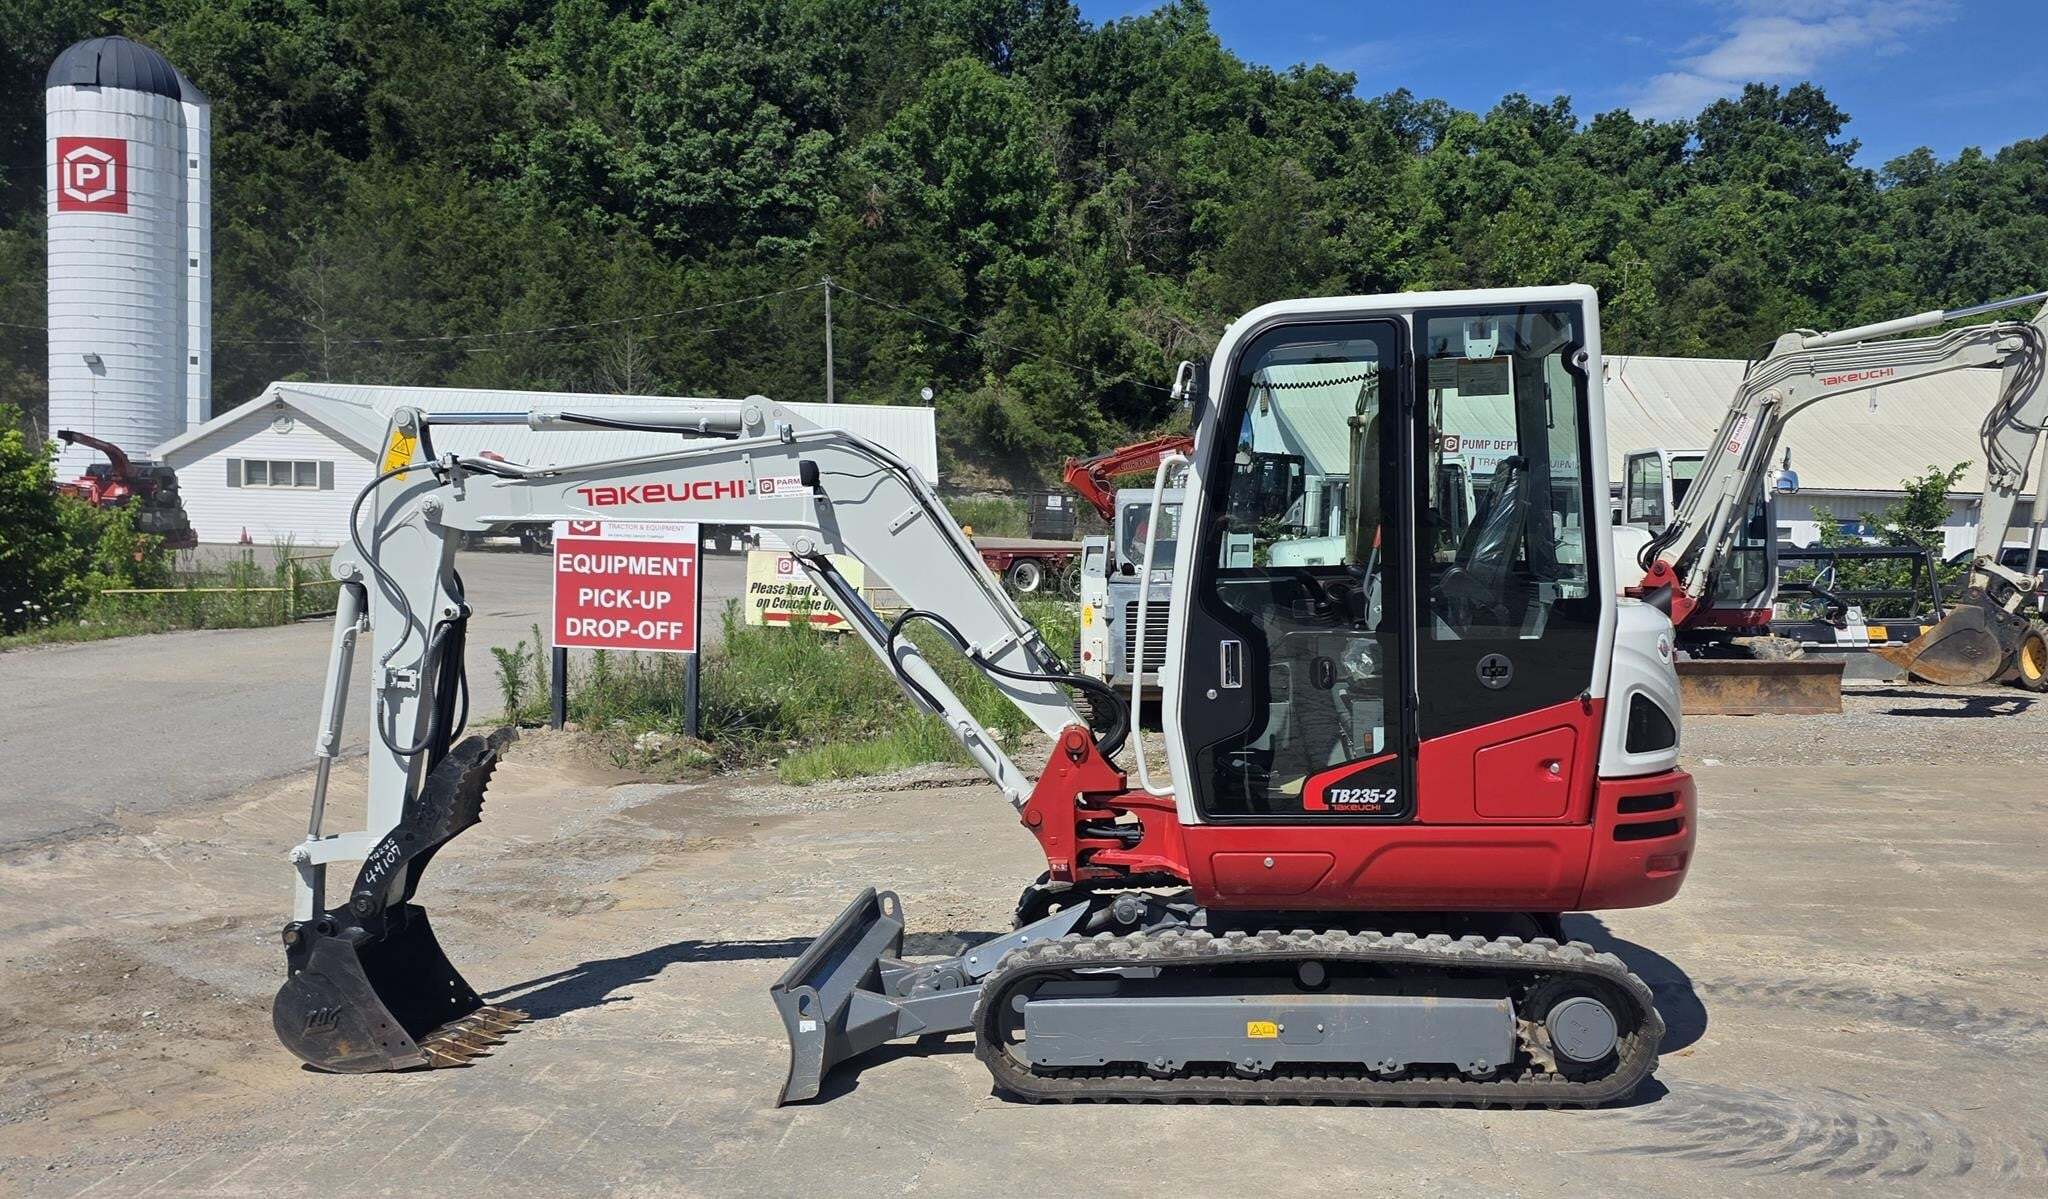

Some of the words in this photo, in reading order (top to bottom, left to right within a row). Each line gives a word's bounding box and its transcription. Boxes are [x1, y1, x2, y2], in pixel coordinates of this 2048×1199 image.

[76, 163, 100, 187] P
[1819, 367, 1895, 386] TAKEUCHI
[1462, 439, 1491, 450] PUMP
[1493, 440, 1518, 451] DEPT
[577, 479, 745, 507] TAKEUCHI
[608, 522, 639, 531] TRACTOR
[646, 524, 685, 532] EQUIPMENT
[559, 553, 693, 577] EQUIPMENT
[579, 588, 672, 610] PICK-UP
[750, 582, 785, 595] Please
[812, 586, 819, 596] &
[756, 598, 770, 608] on
[772, 597, 822, 610] Concte
[566, 617, 683, 641] DROP-OFF
[1330, 788, 1397, 804] TB235-2
[365, 844, 401, 884] 44107
